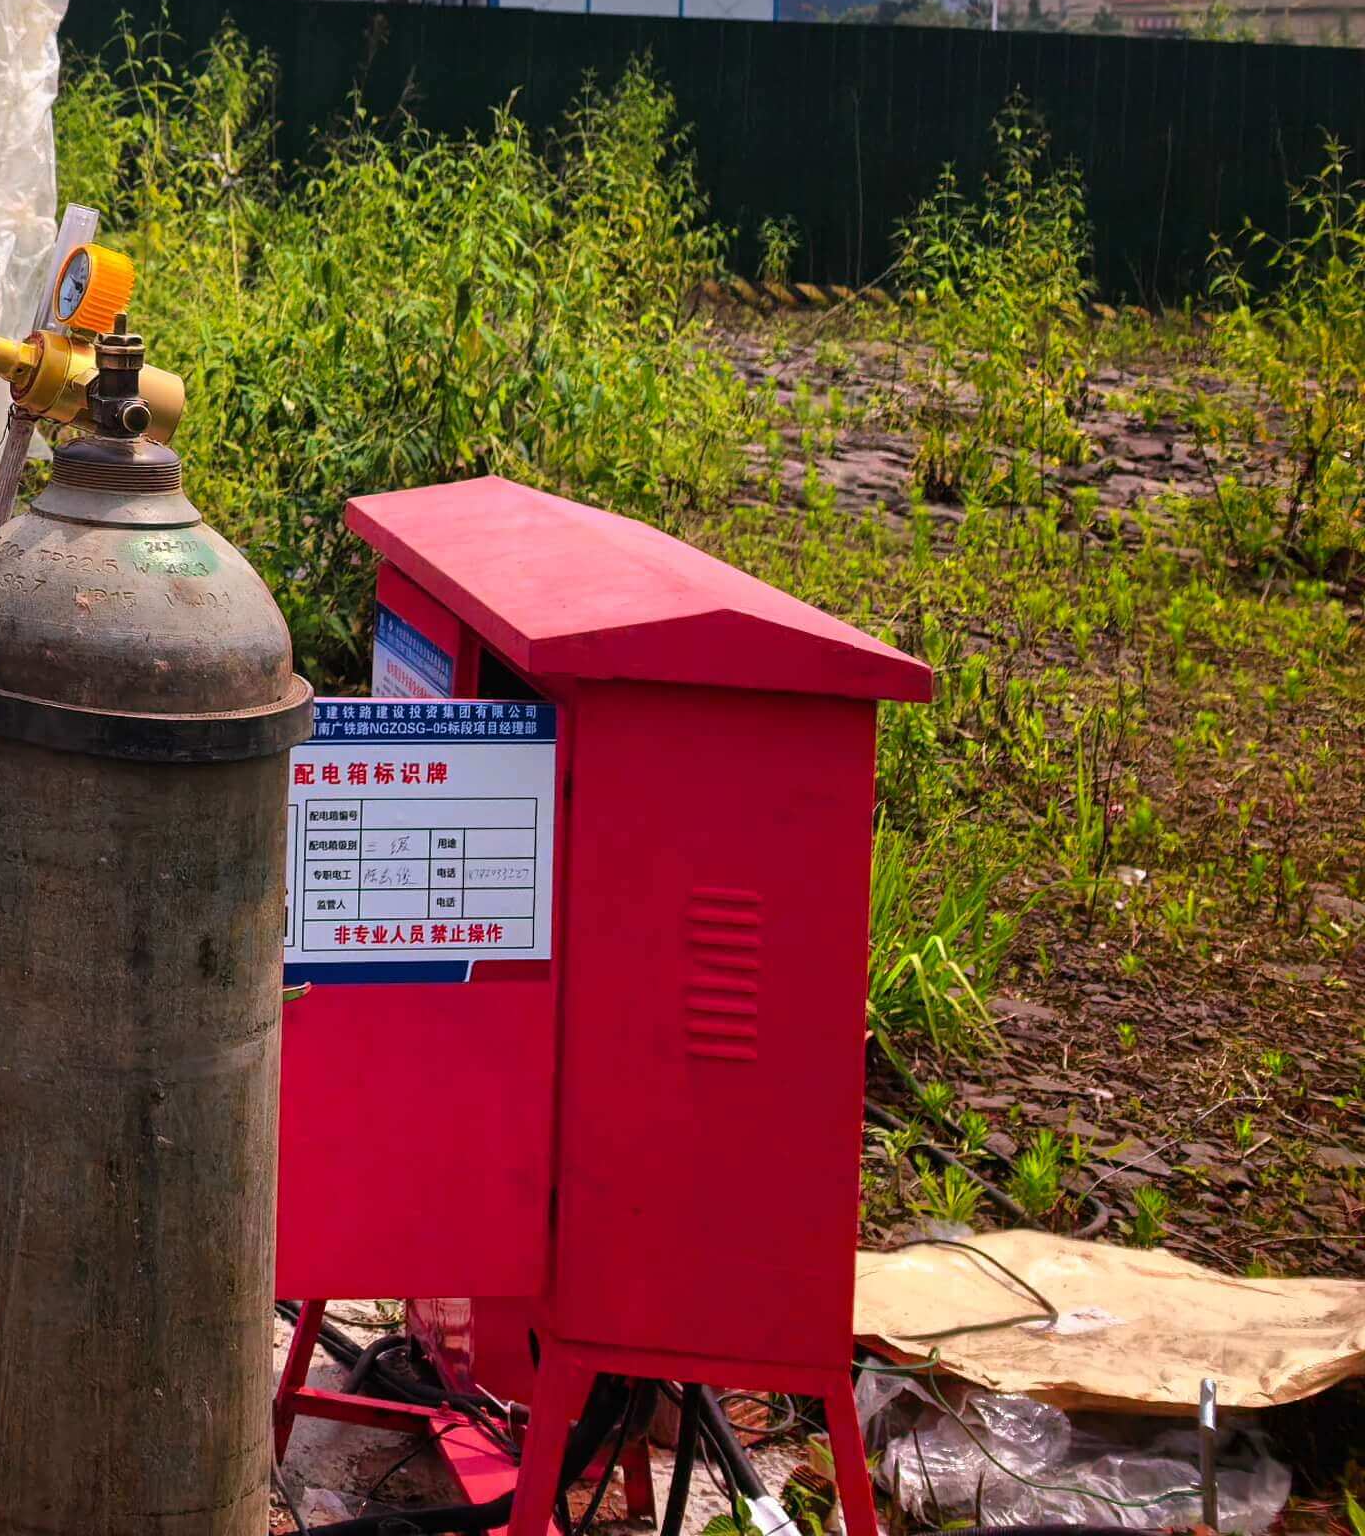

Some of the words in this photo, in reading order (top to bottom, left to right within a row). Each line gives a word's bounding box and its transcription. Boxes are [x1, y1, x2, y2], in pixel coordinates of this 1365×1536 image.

[314, 720, 537, 736] 南广铁路NGZQSG-05标段项目经理部
[294, 762, 449, 785] 配电箱标识牌
[309, 810, 358, 822] 配电箱编号
[308, 839, 357, 852] 配电箱级别
[437, 838, 457, 849] 用途
[313, 869, 352, 881] 专职电工
[436, 867, 457, 879] 电话
[316, 899, 347, 911] 监管人
[436, 896, 456, 908] 电话
